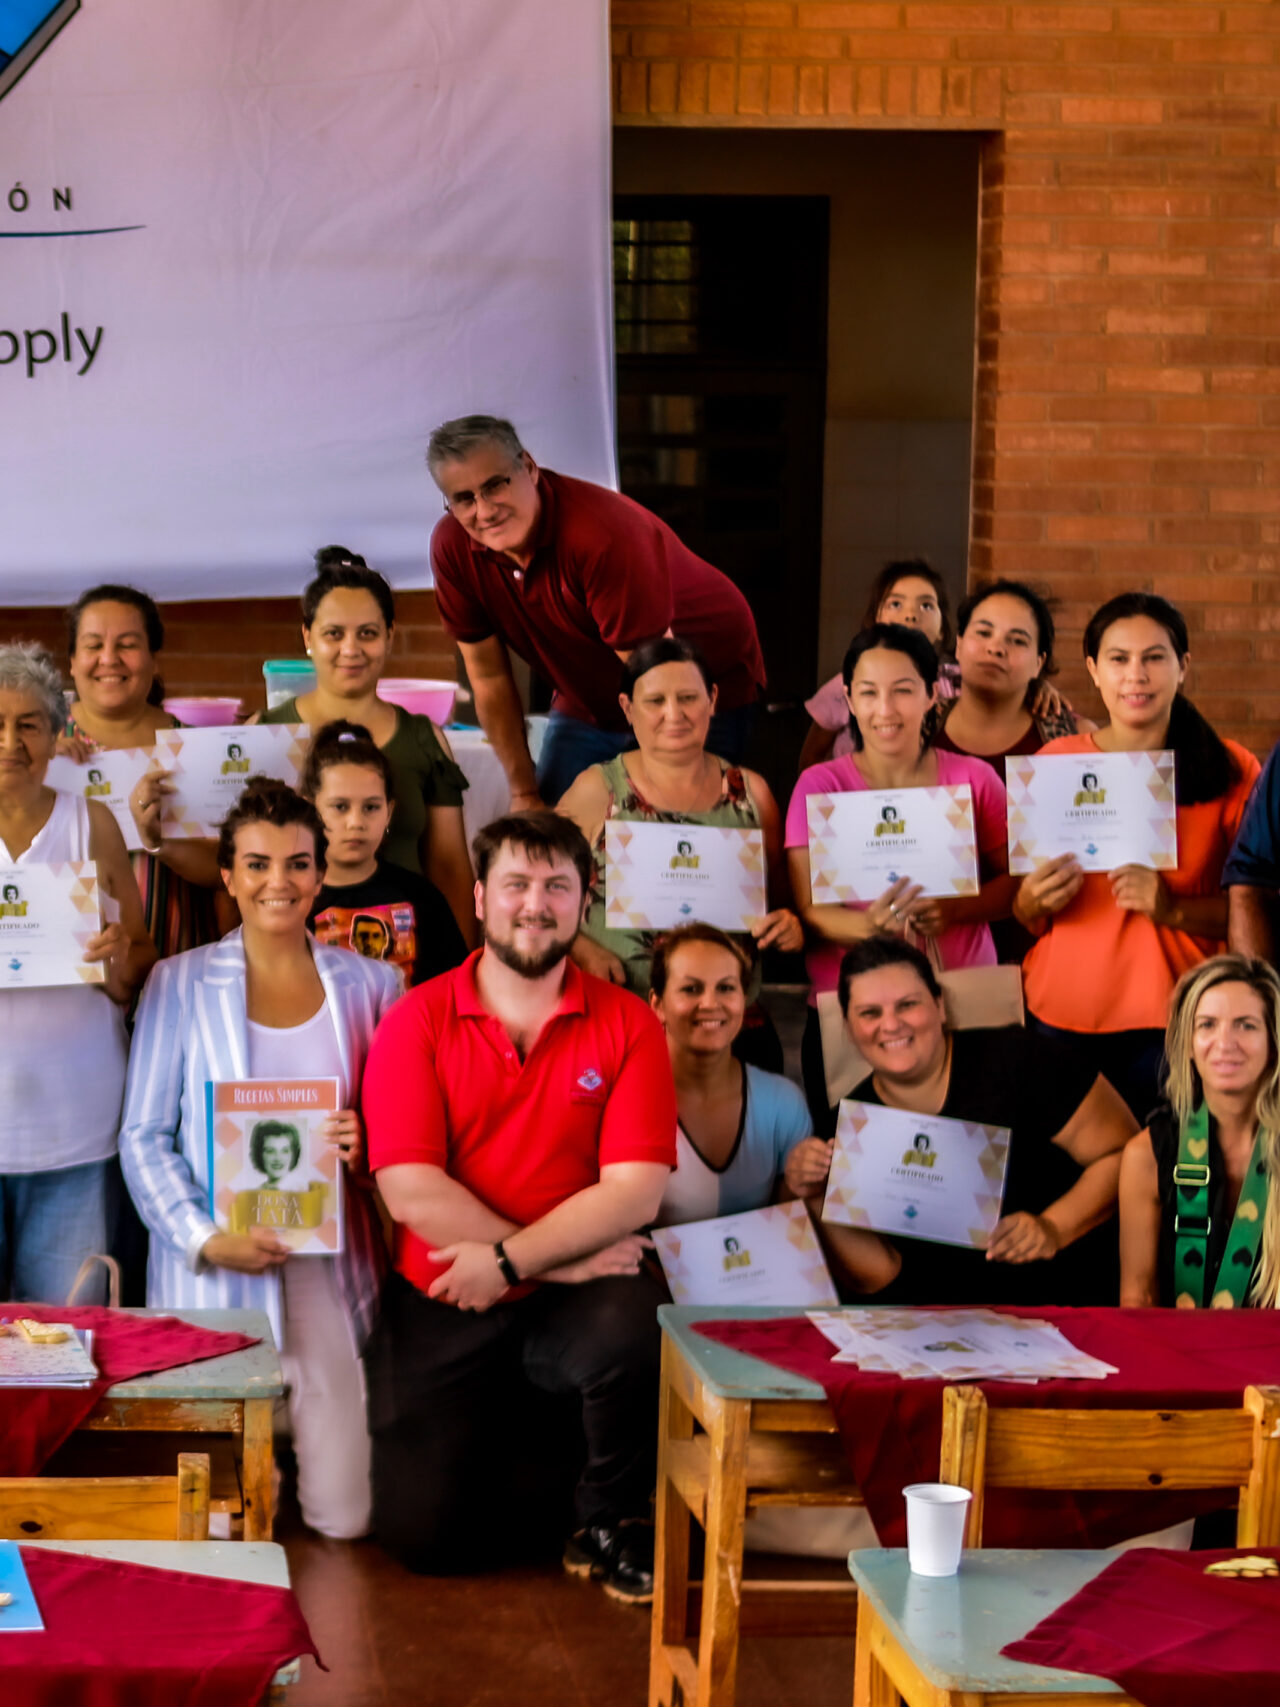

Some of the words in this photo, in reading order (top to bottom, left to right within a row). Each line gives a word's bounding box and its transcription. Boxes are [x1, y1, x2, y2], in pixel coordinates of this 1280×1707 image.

[233, 1087, 274, 1105] RECETAS
[276, 1086, 318, 1104] SIMPLES
[251, 1206, 304, 1225] TATA
